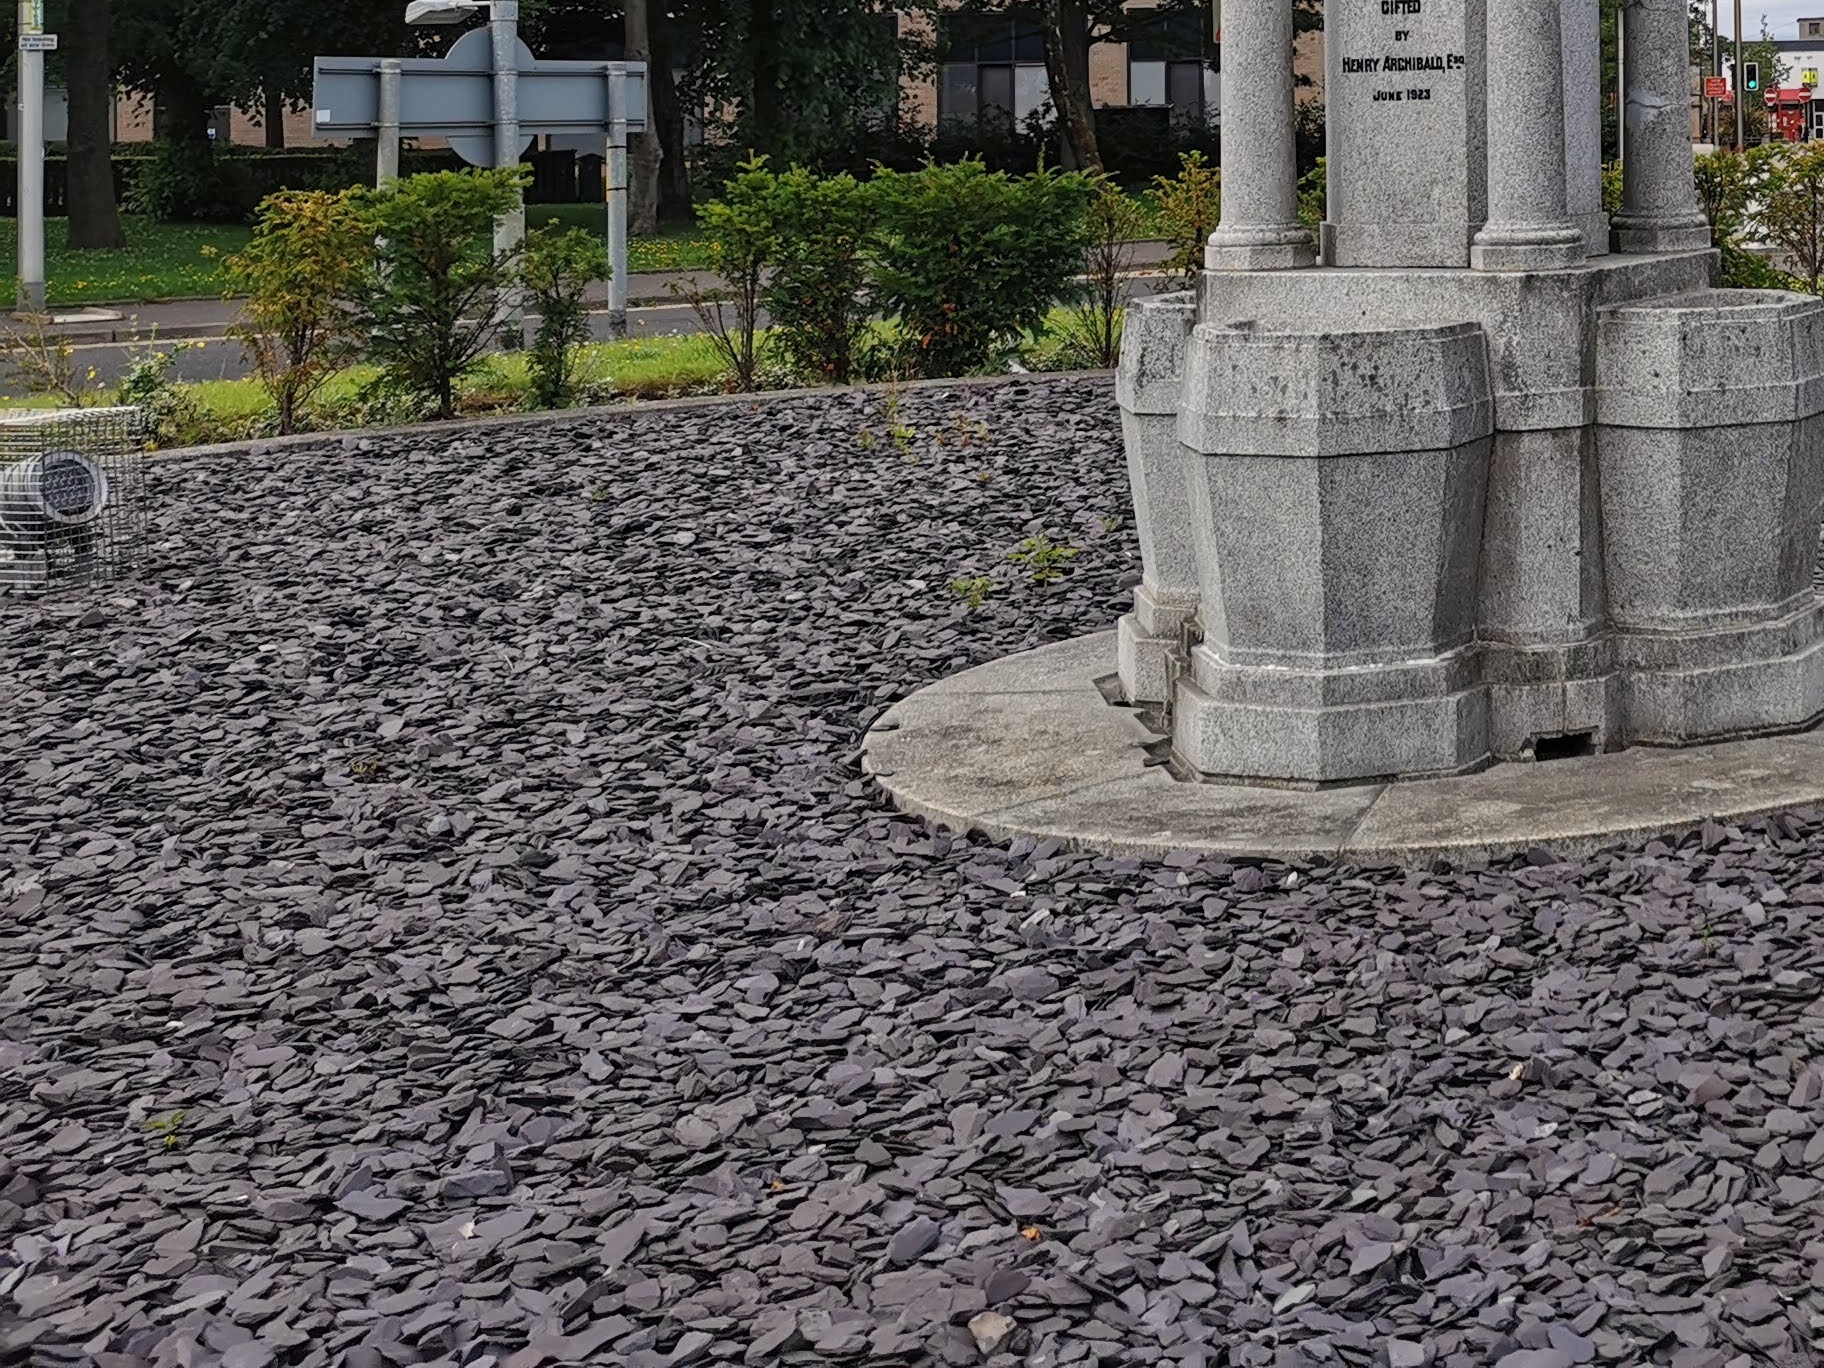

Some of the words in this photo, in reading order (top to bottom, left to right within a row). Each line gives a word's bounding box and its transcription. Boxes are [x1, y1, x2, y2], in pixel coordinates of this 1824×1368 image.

[1381, 0, 1421, 15] GIFTED
[1395, 30, 1410, 41] BY
[1342, 56, 1380, 73] HENRY
[1373, 90, 1403, 101] JUNE
[1406, 89, 1431, 101] 1923
